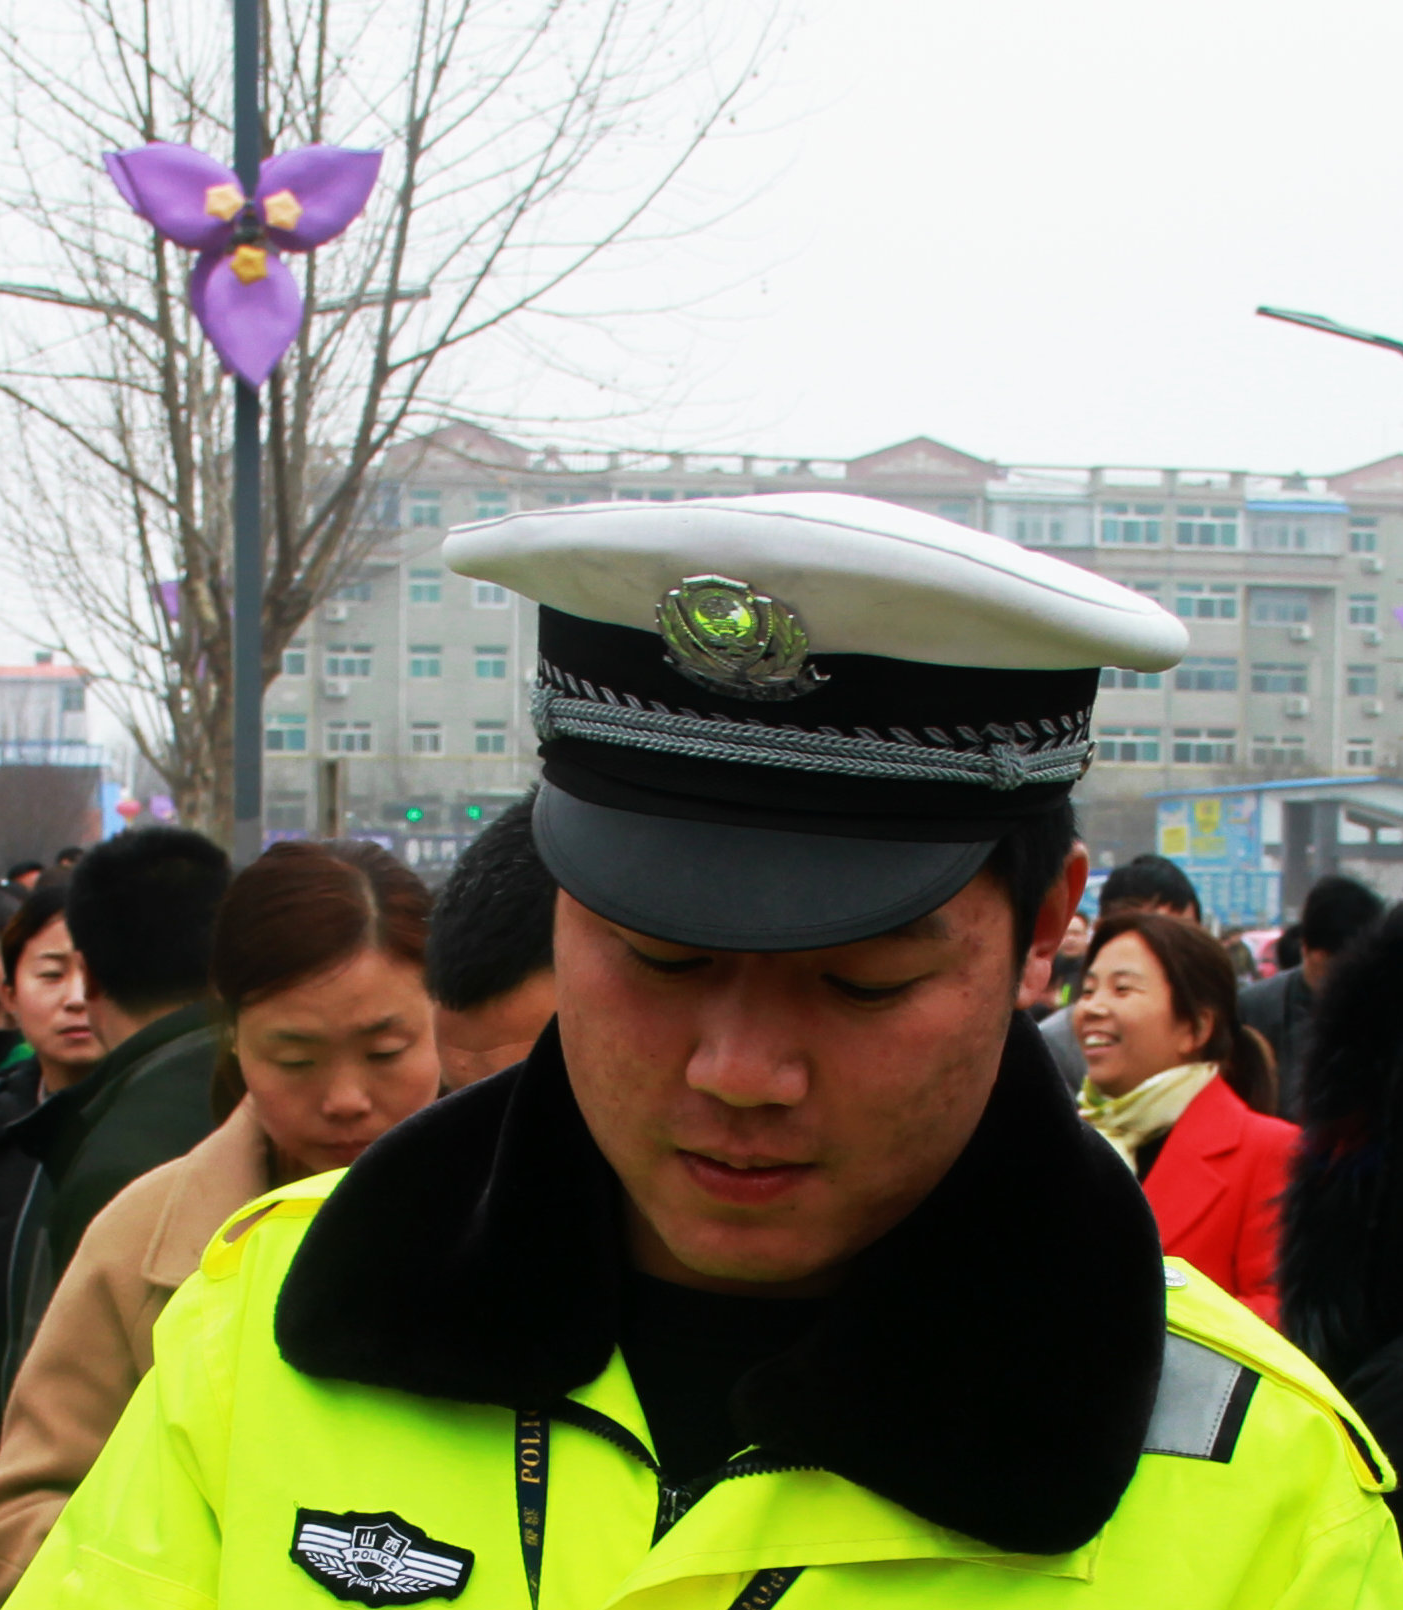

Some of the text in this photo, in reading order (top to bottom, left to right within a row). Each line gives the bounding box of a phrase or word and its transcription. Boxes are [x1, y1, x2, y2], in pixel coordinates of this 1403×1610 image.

[520, 1408, 541, 1484] POLI
[359, 1530, 403, 1556] 山西
[351, 1549, 397, 1571] POLICE
